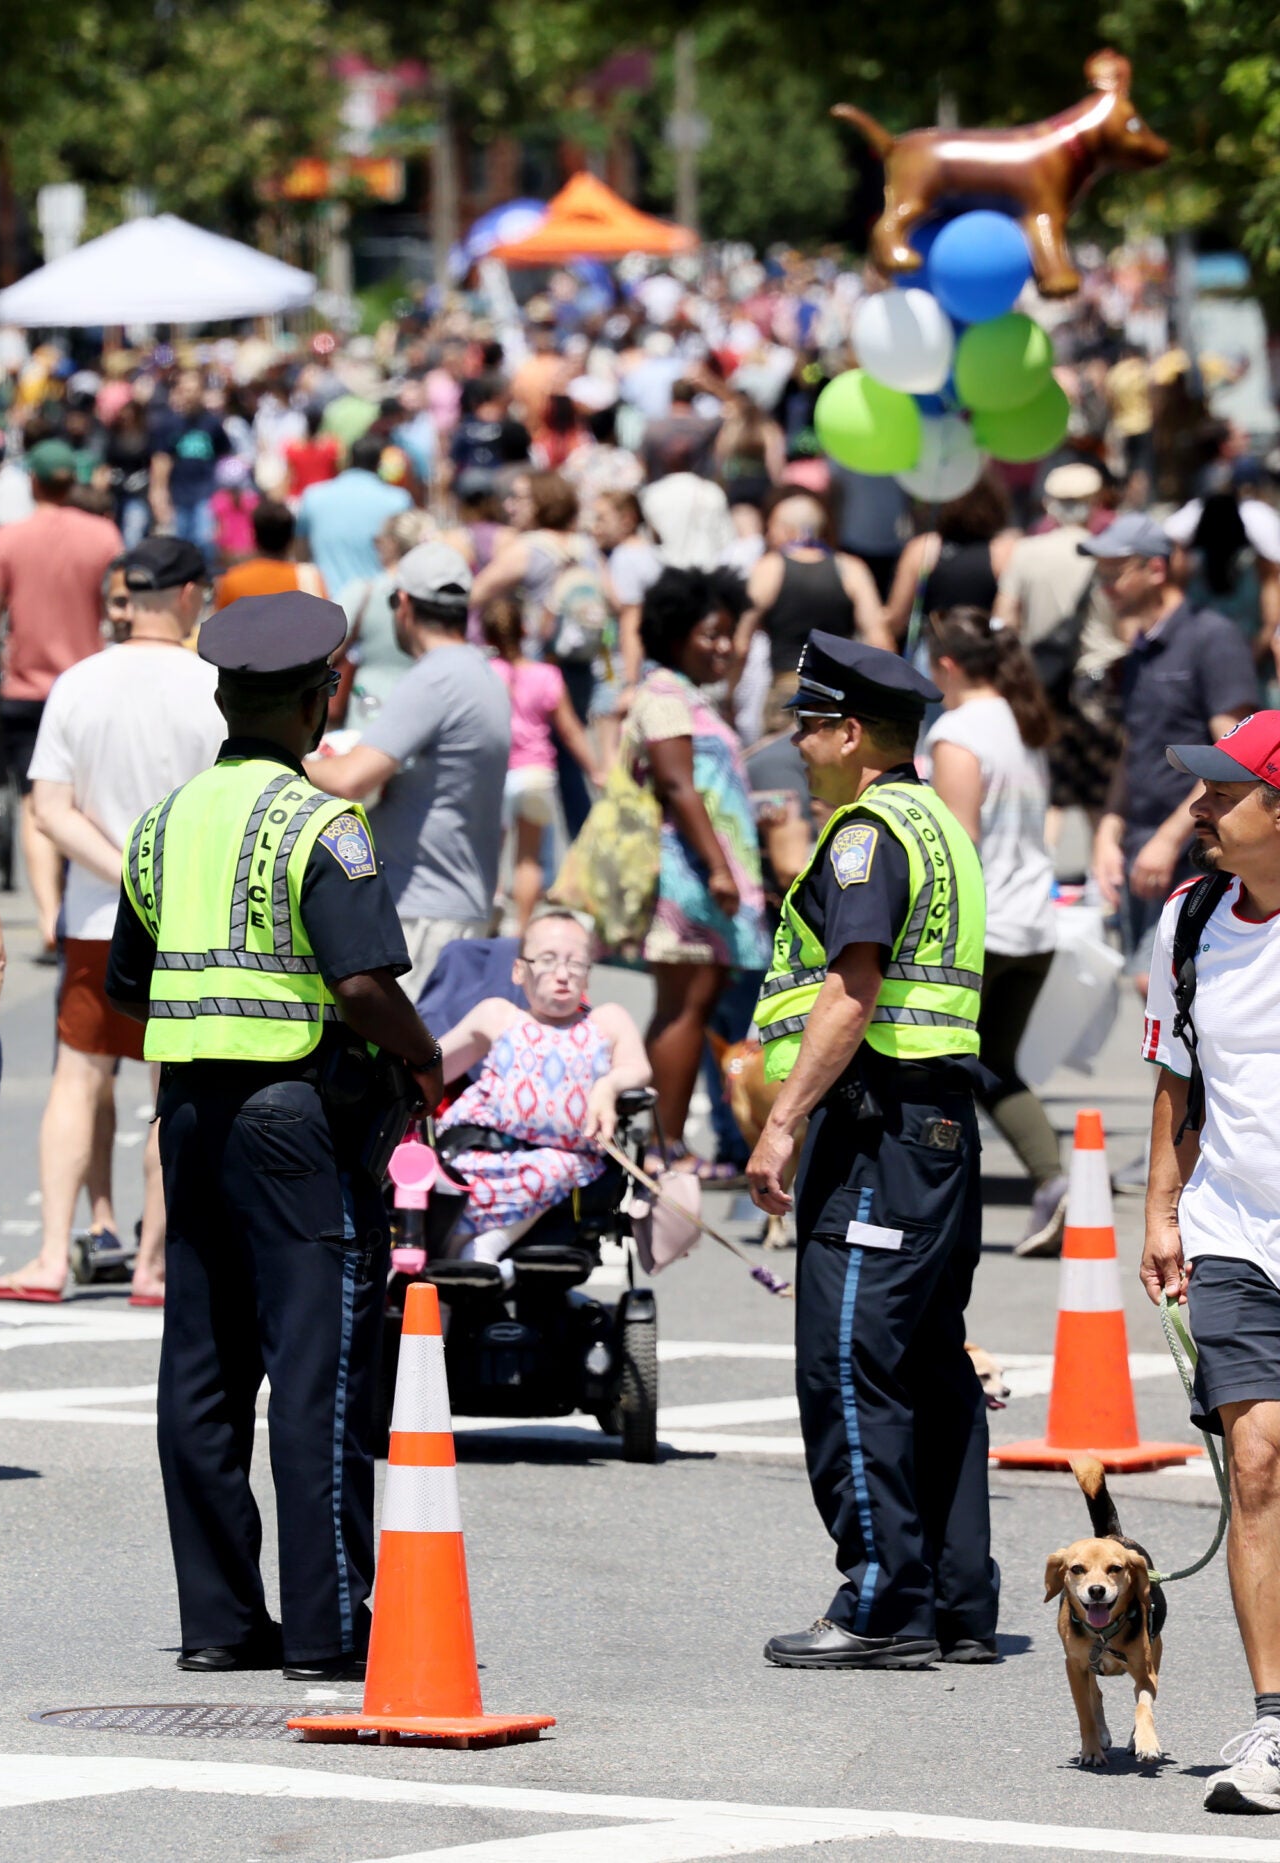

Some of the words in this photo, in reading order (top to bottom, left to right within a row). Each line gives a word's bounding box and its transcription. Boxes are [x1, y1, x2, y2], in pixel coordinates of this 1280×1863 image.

[248, 789, 303, 930] POLICE
[323, 816, 359, 836] BOSTON
[328, 825, 360, 841] POLICE
[832, 829, 872, 850] BOSTON
[140, 800, 162, 934] OSTON
[906, 808, 948, 944] BOSTON
